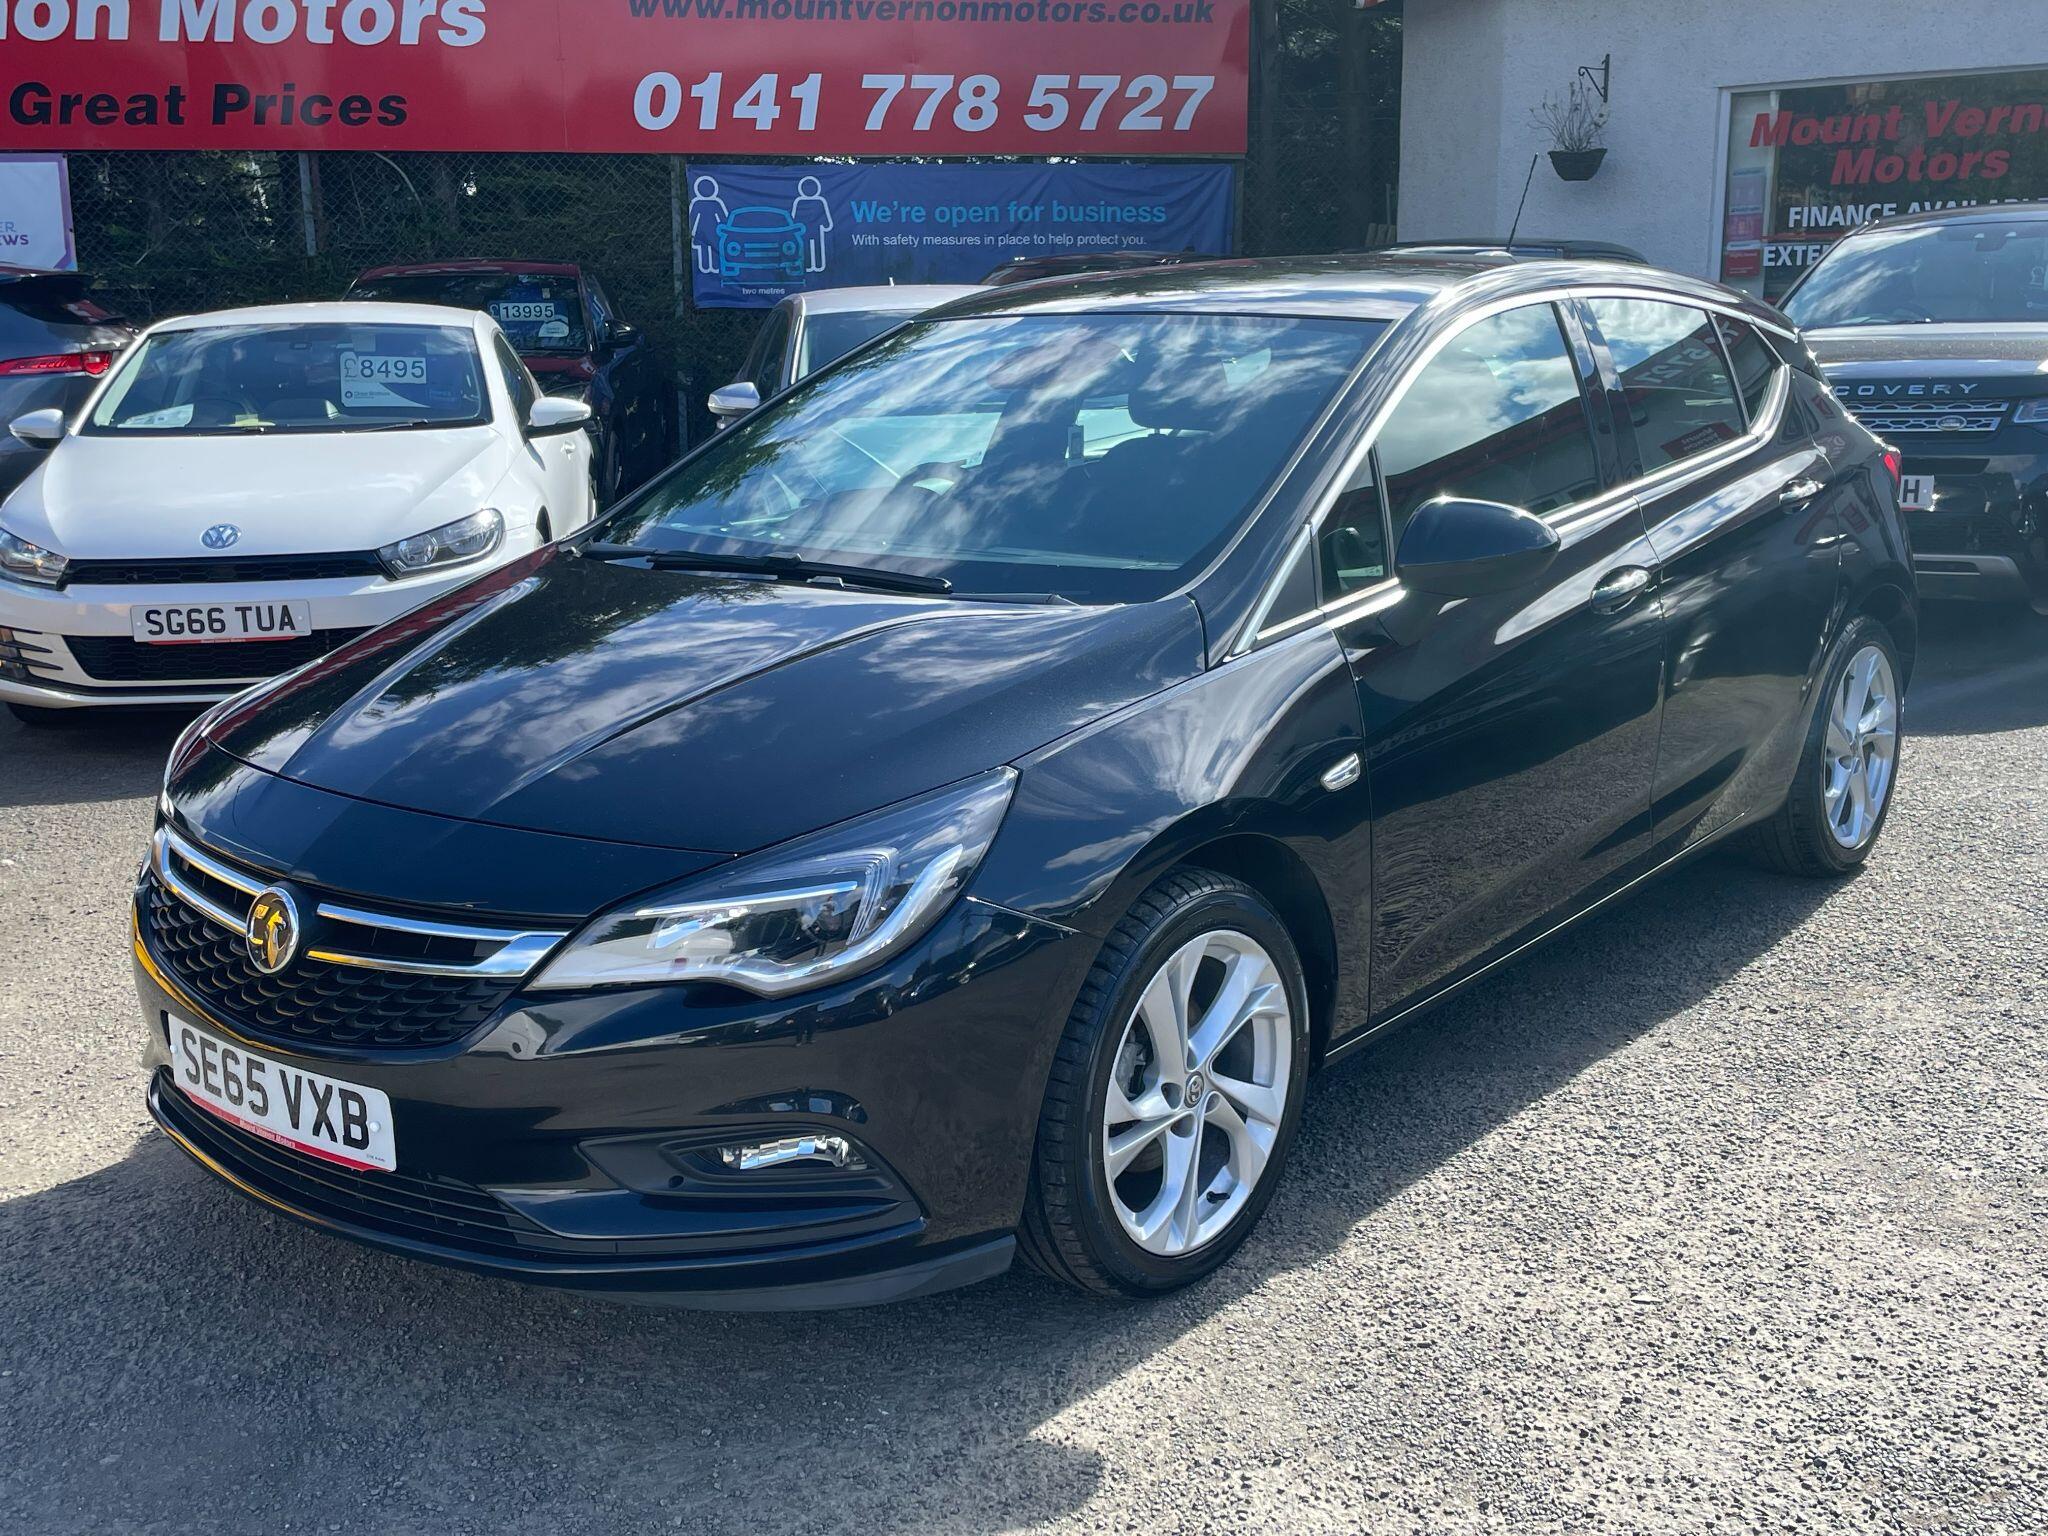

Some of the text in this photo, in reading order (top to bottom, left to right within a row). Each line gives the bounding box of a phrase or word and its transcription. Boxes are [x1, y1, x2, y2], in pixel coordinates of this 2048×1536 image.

[0, 0, 486, 47] on Motors
[629, 0, 1215, 24] www.mountvernonmotors.co.uk
[9, 82, 408, 127] Great Prices
[633, 72, 1215, 132] 0141 778 5727
[1750, 105, 1903, 147] Mount
[1831, 147, 2011, 185] Motors
[934, 206, 999, 227] open
[1008, 201, 1045, 223] for
[1052, 200, 1168, 223] business
[1789, 203, 1897, 228] FINANCE
[0, 234, 29, 246] WS
[852, 234, 1147, 247] With safety measures in place to help protect you.
[742, 287, 785, 295] two metres
[145, 605, 296, 635] SG66 TUA
[181, 1028, 369, 1150] SE65 VXB
